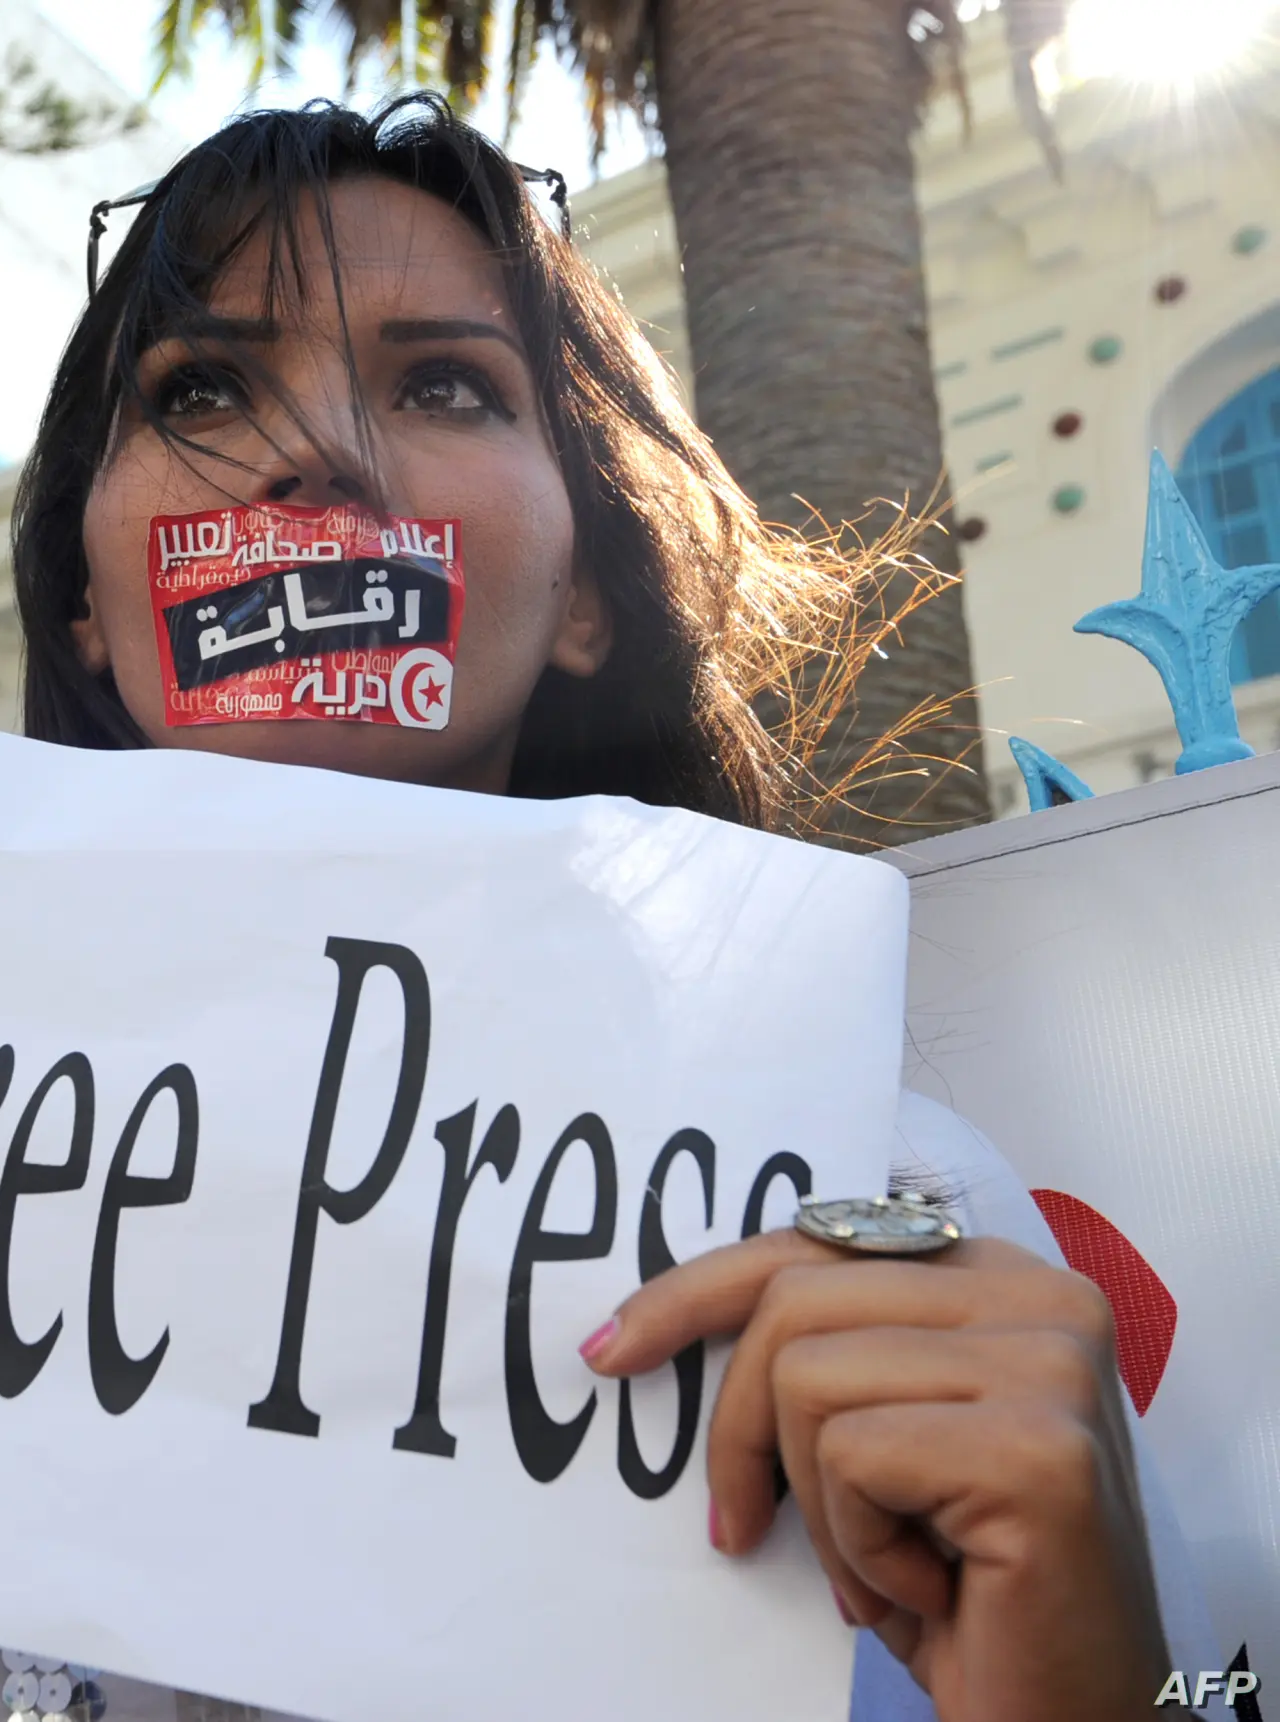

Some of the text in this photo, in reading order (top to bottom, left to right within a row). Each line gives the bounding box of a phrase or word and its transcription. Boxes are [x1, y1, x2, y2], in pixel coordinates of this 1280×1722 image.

[158, 510, 455, 571] إعلام صحافة تعبير
[197, 569, 422, 661] رقابة
[291, 657, 388, 716] حرية
